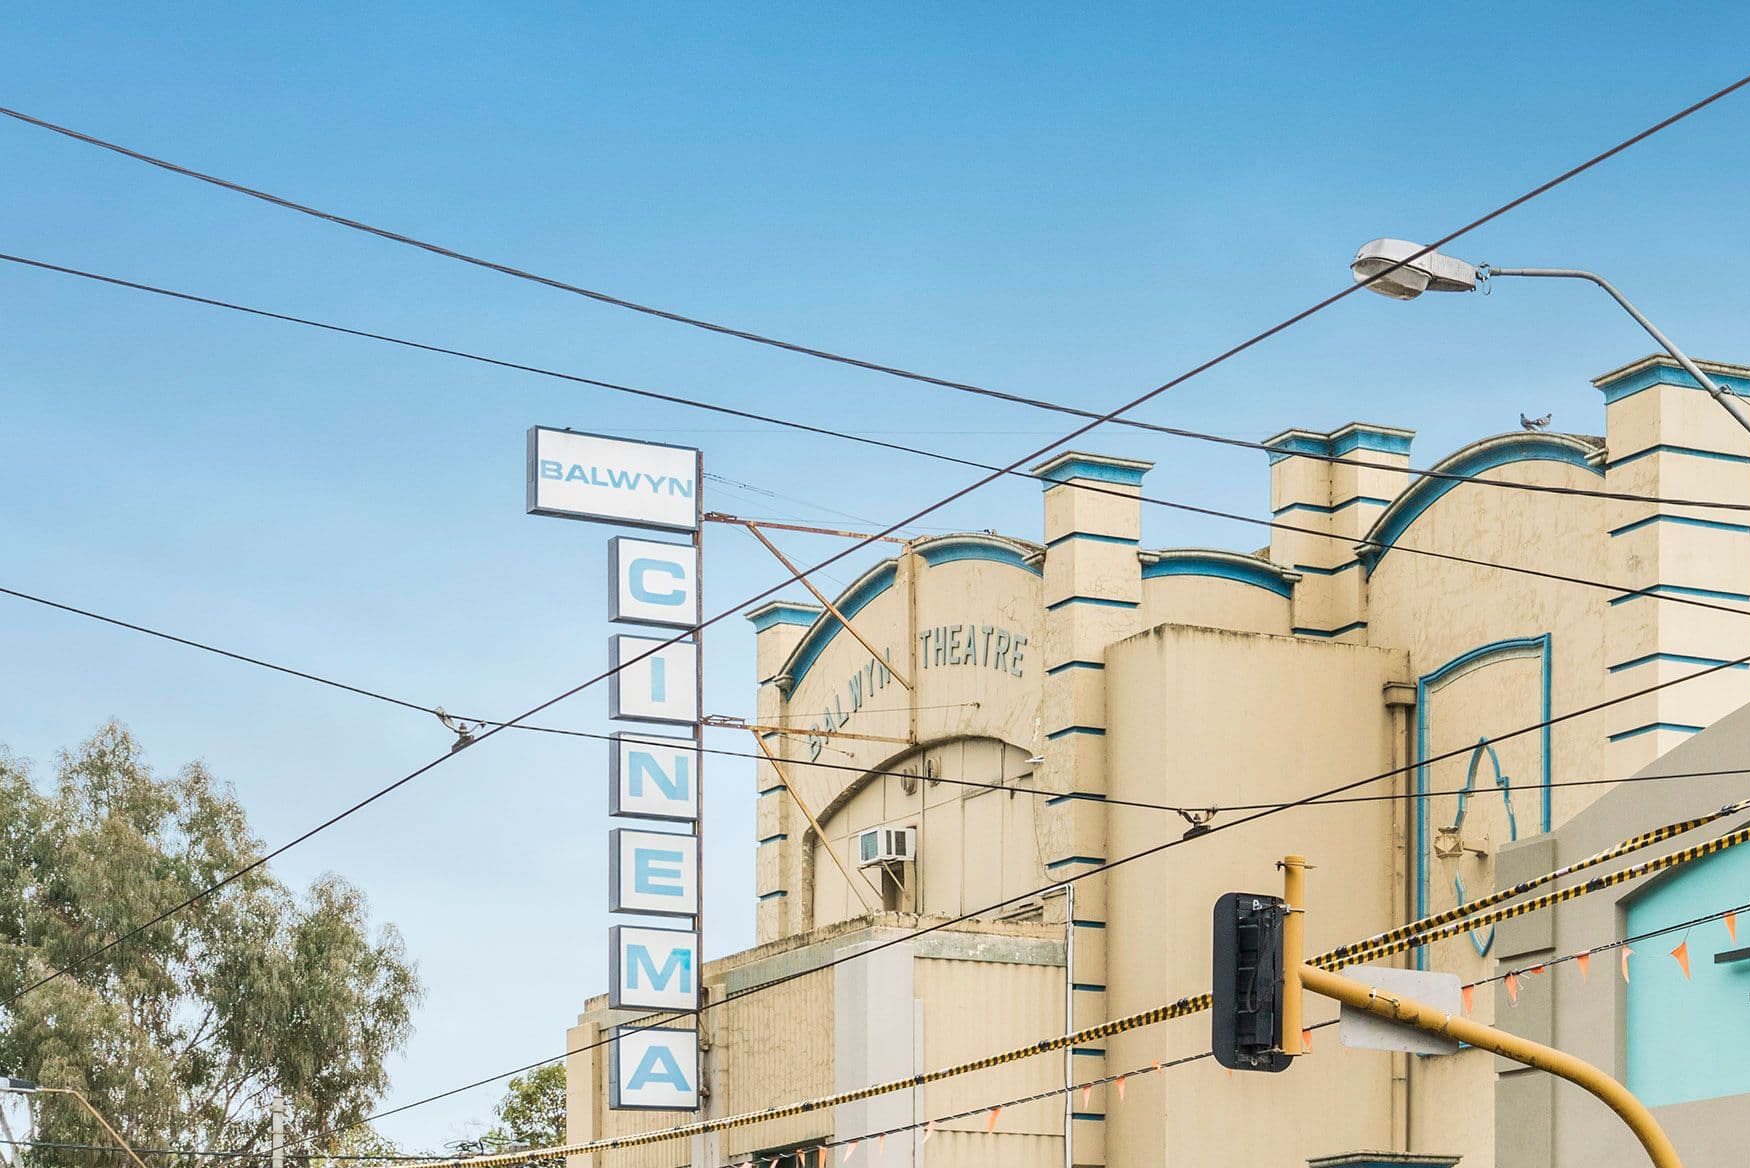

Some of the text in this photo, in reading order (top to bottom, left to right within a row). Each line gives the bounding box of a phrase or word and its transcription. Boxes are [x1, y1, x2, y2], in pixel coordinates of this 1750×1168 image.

[540, 459, 693, 498] BALWYN
[806, 624, 1028, 763] BALWYN THEATRE
[626, 557, 693, 1091] CINEMA
